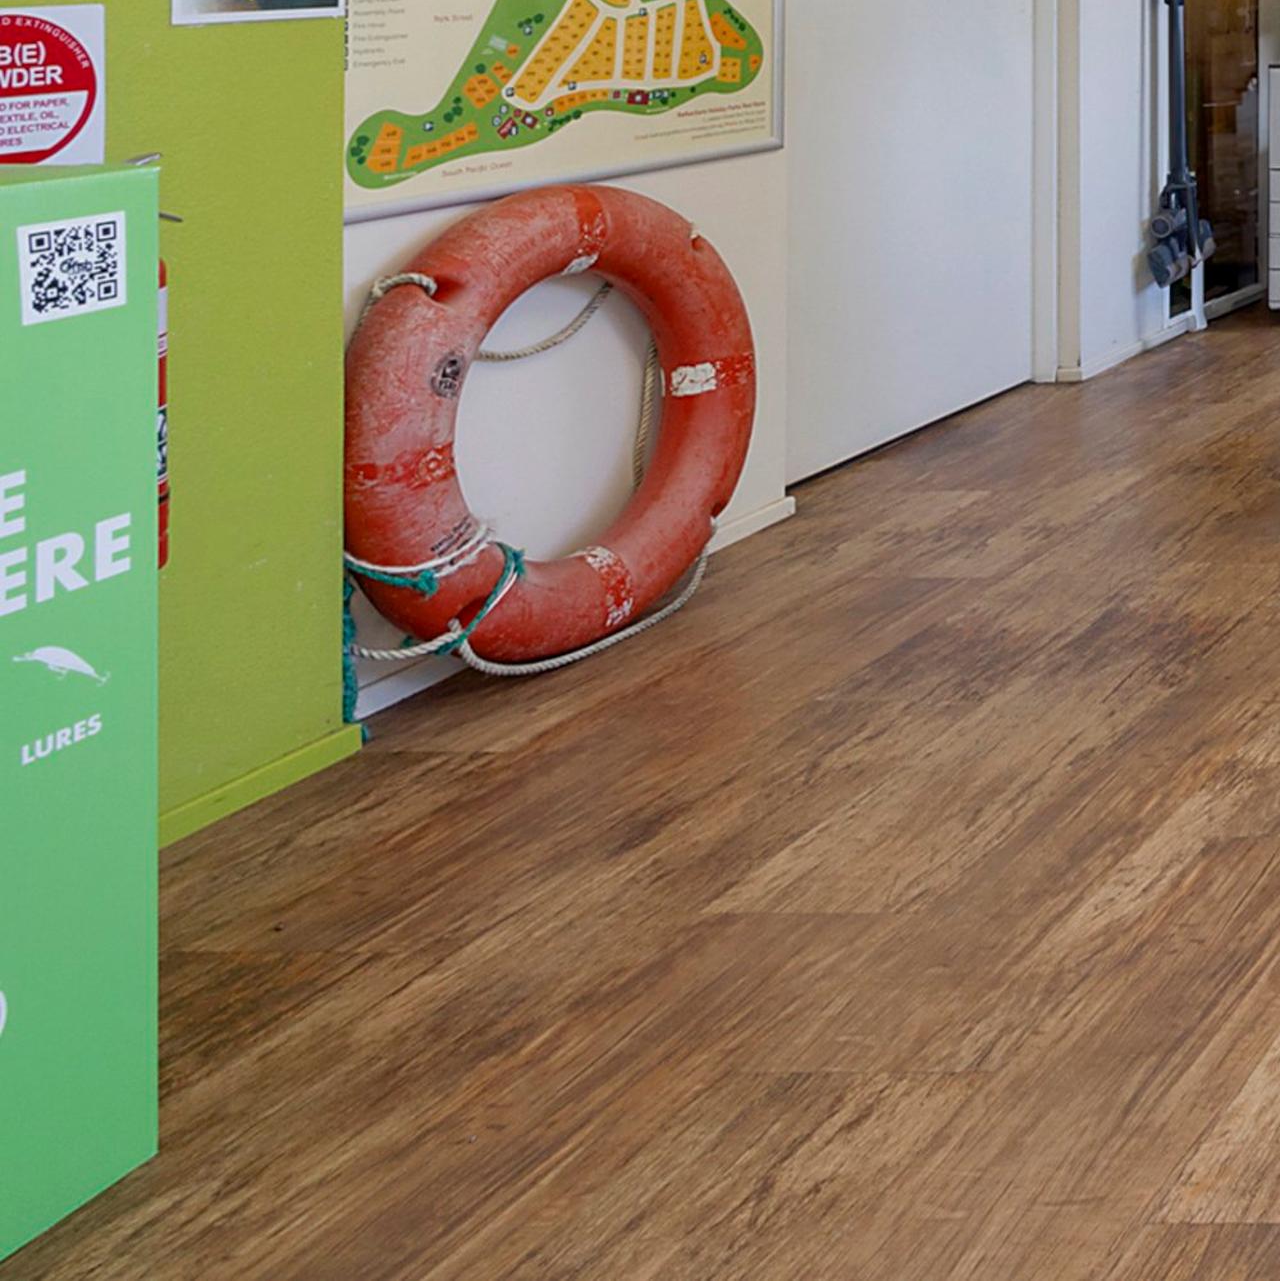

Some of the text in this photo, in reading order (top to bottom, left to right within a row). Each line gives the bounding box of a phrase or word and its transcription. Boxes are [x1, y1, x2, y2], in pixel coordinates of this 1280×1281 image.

[15, 16, 91, 69] EXTINGUISHER
[7, 121, 70, 135] ELECTRICAL
[9, 101, 32, 111] FOR
[0, 512, 132, 617] ERE
[21, 713, 102, 767] LURES
